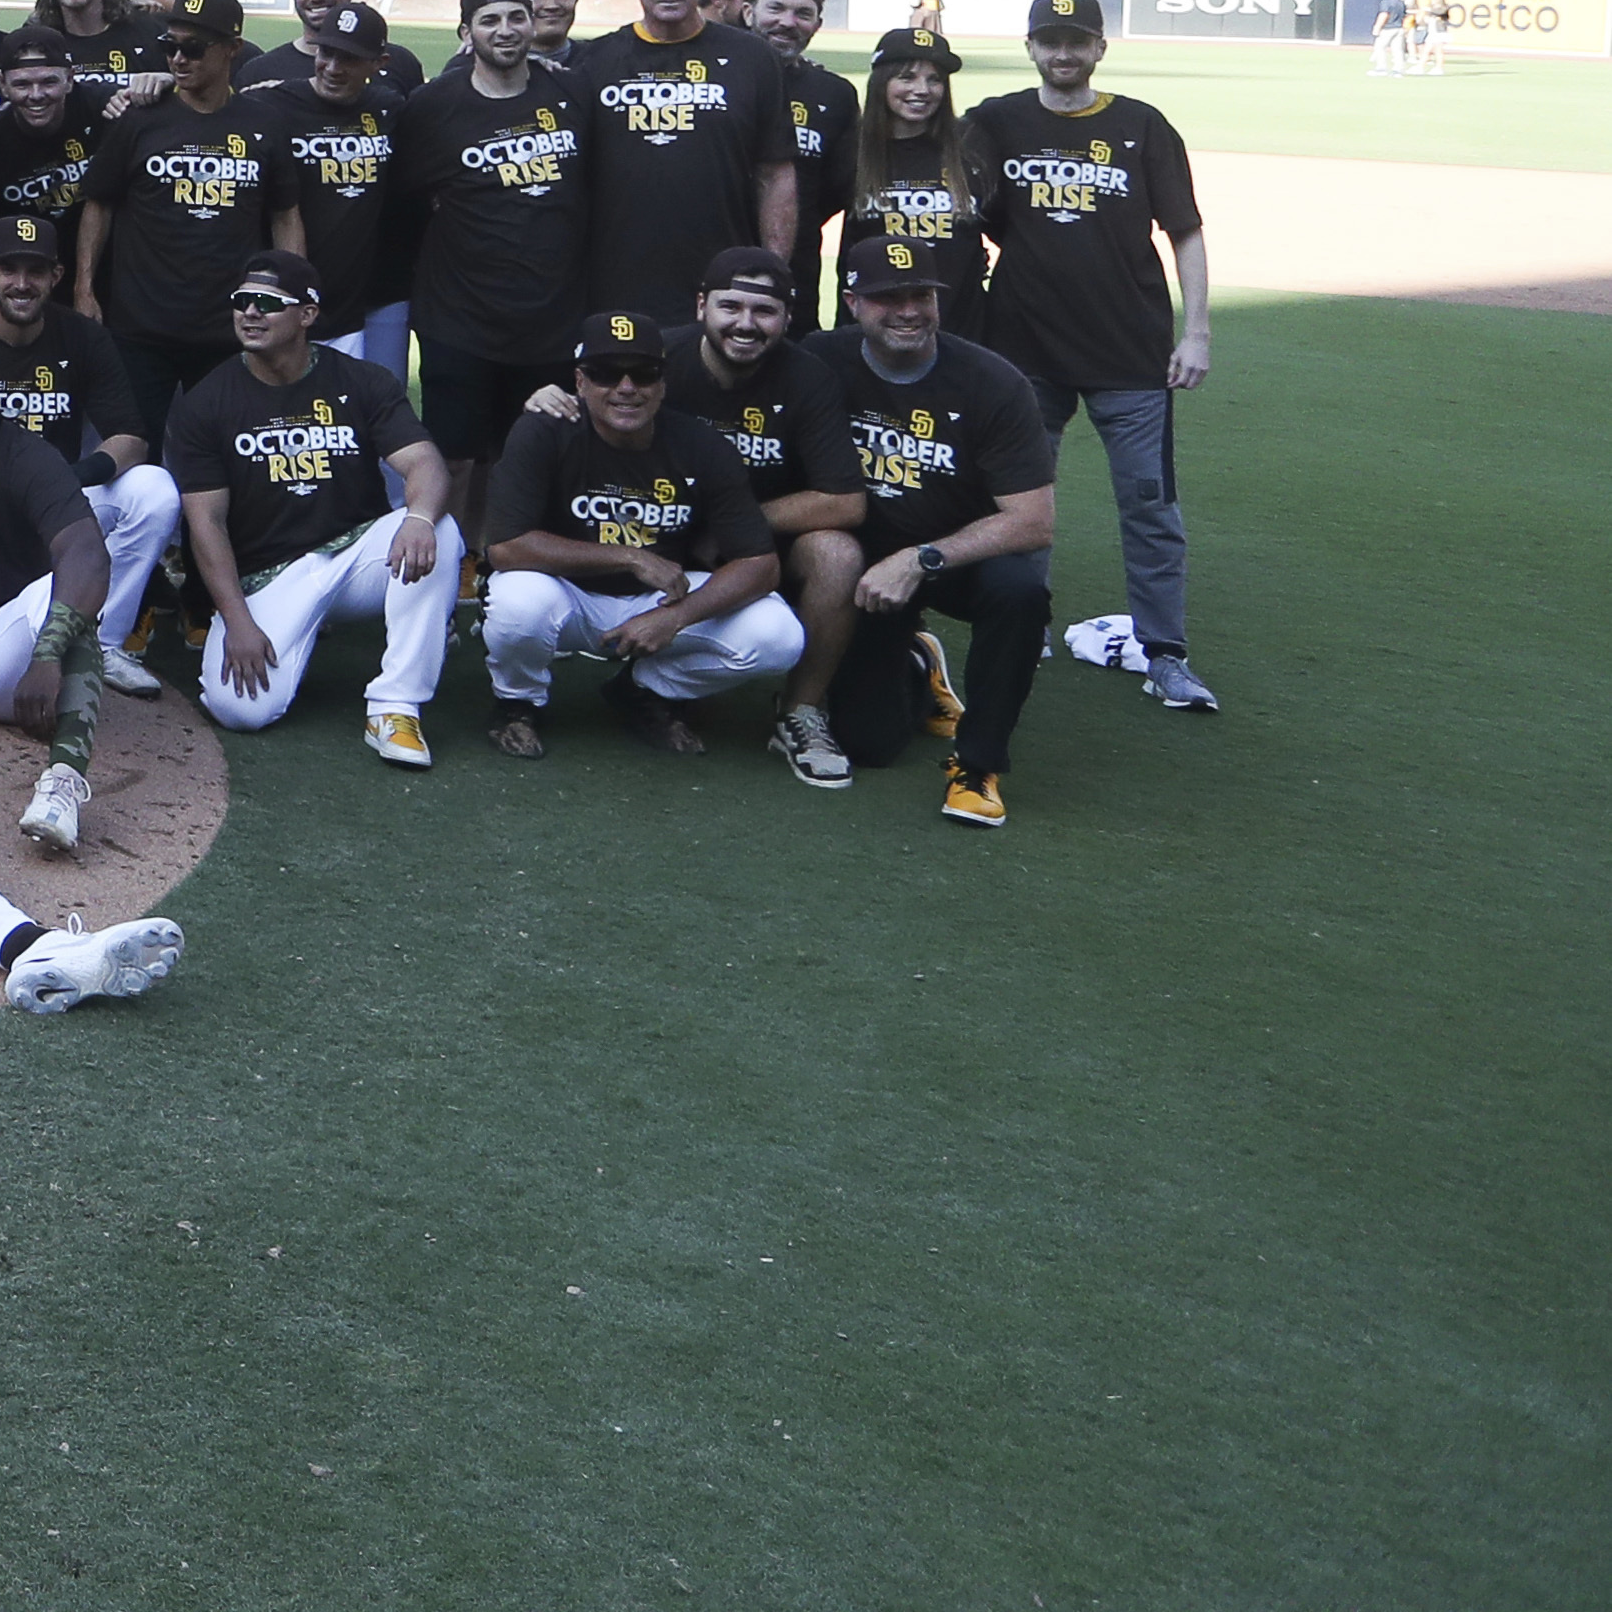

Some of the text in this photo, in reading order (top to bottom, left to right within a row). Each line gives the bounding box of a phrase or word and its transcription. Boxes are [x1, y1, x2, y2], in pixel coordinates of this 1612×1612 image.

[601, 84, 726, 107] OCTOBER
[628, 105, 694, 130] RISE
[292, 135, 391, 160] OCTOBER
[461, 130, 576, 168] OCTOBER
[146, 156, 260, 180] OCTOBER
[321, 157, 378, 184] RISE
[499, 155, 561, 186] RISE
[1005, 159, 1128, 190] OCTOBER
[174, 179, 236, 207] RISE
[1031, 184, 1096, 212] RISE
[885, 212, 953, 238] RISE
[235, 426, 359, 455] OCTOBER
[269, 450, 333, 482] RISE
[571, 497, 691, 525] OCTOBER
